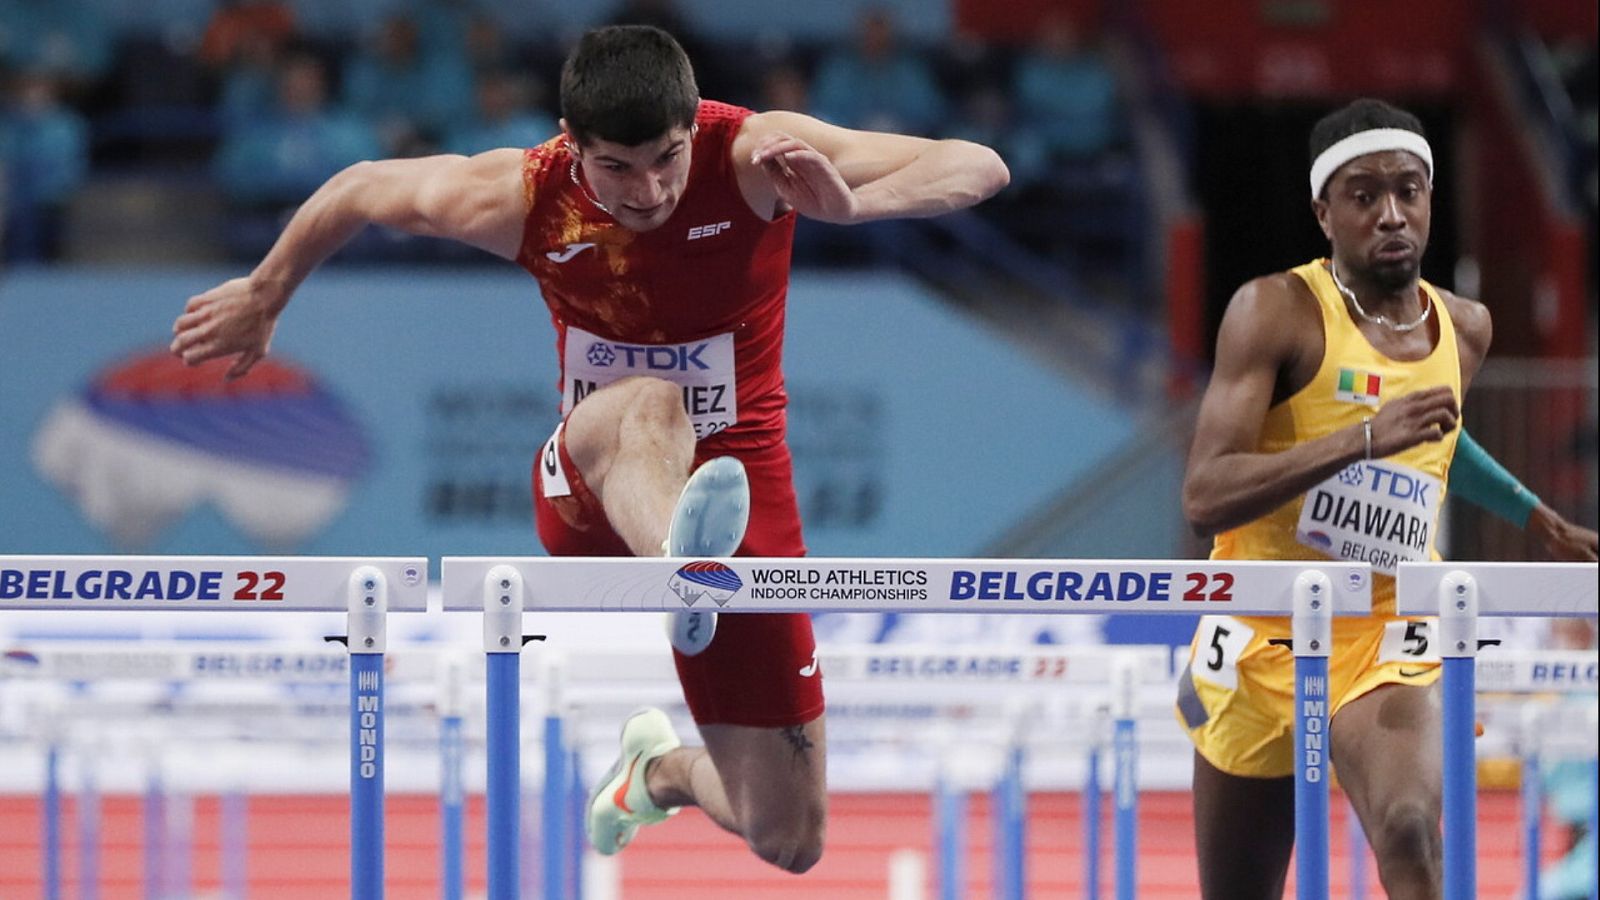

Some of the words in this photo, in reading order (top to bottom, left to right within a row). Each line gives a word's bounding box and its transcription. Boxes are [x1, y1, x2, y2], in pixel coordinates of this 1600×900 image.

[688, 221, 731, 240] ESP
[616, 344, 710, 372] TDK
[1366, 465, 1429, 507] TDK
[1311, 491, 1428, 553] DIAWARA
[1341, 541, 1414, 569] BELGRA
[0, 569, 223, 601] BELGRADE
[233, 571, 286, 601] 22
[751, 569, 821, 585] WORLD
[825, 569, 928, 586] ATHLETICS
[949, 571, 1173, 602] BELGRADE
[1183, 572, 1235, 602] 22
[751, 587, 807, 600] INDOOR
[809, 588, 928, 601] CHAMPIONSHIPS
[1207, 624, 1231, 672] 5
[1403, 621, 1429, 657] 5
[358, 696, 379, 778] MONDO
[1304, 701, 1325, 784] MONDO
